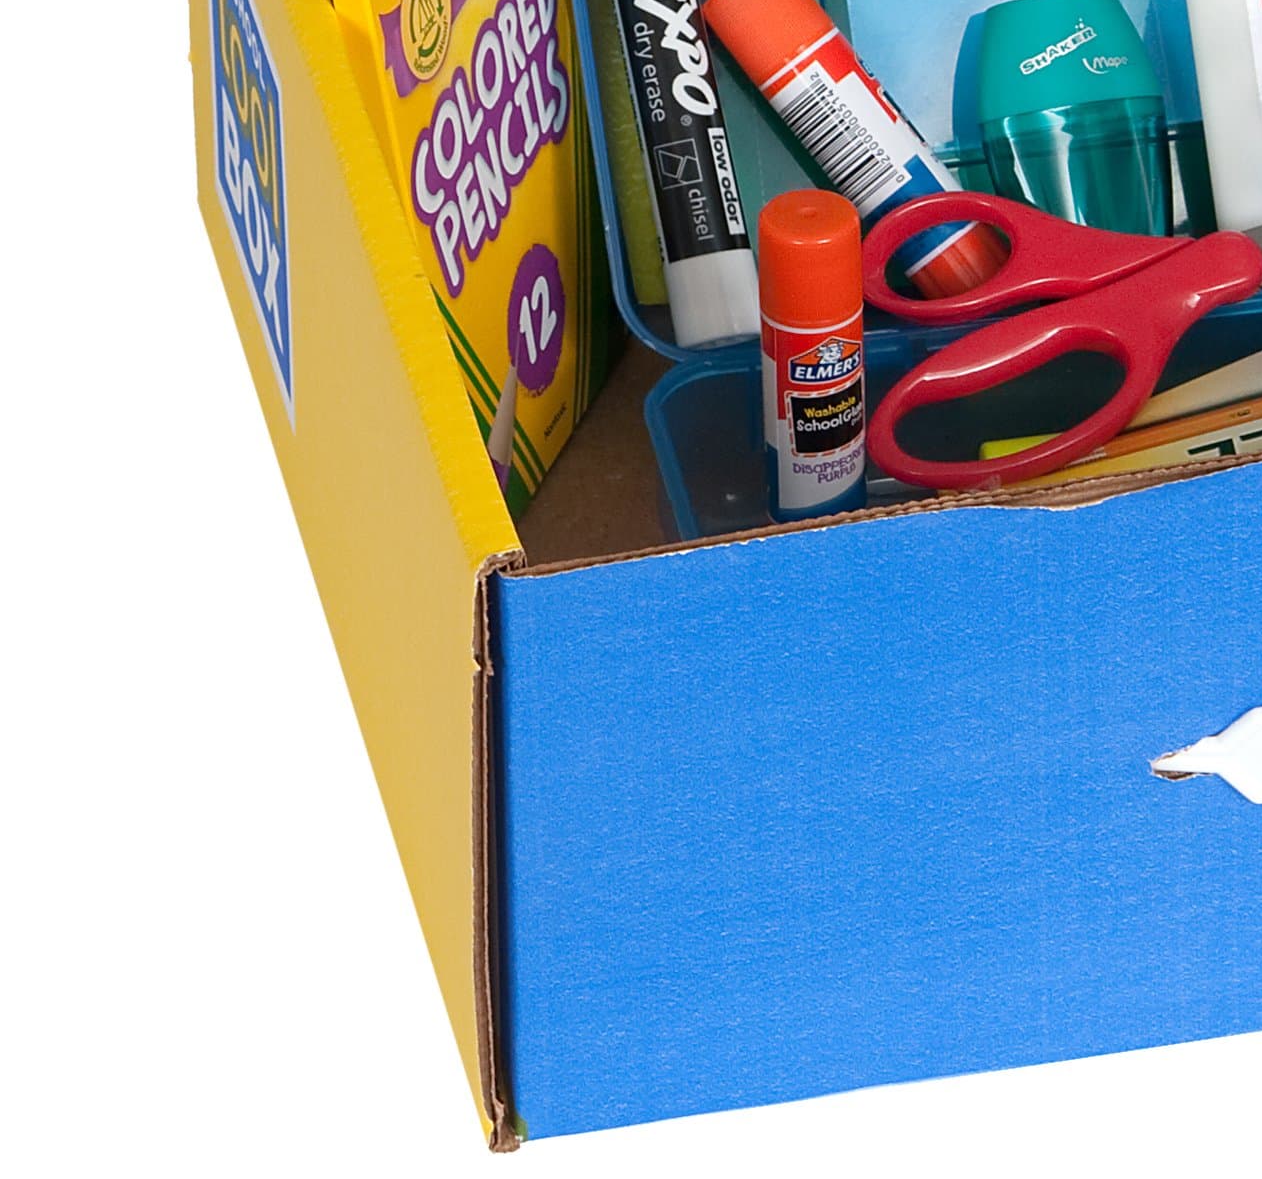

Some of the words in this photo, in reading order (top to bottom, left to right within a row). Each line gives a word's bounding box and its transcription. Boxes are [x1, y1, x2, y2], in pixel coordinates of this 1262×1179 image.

[633, 21, 655, 63] dry
[1020, 27, 1096, 74] SHAKER
[641, 63, 667, 123] erase
[434, 38, 568, 287] PENCILS
[711, 134, 728, 172] low
[896, 173, 906, 183] 0
[221, 85, 284, 357] BOX
[686, 187, 716, 241] chisel
[716, 173, 741, 226] odor
[519, 275, 558, 365] 12
[794, 352, 861, 381] ELMER'S
[796, 411, 843, 433] School
